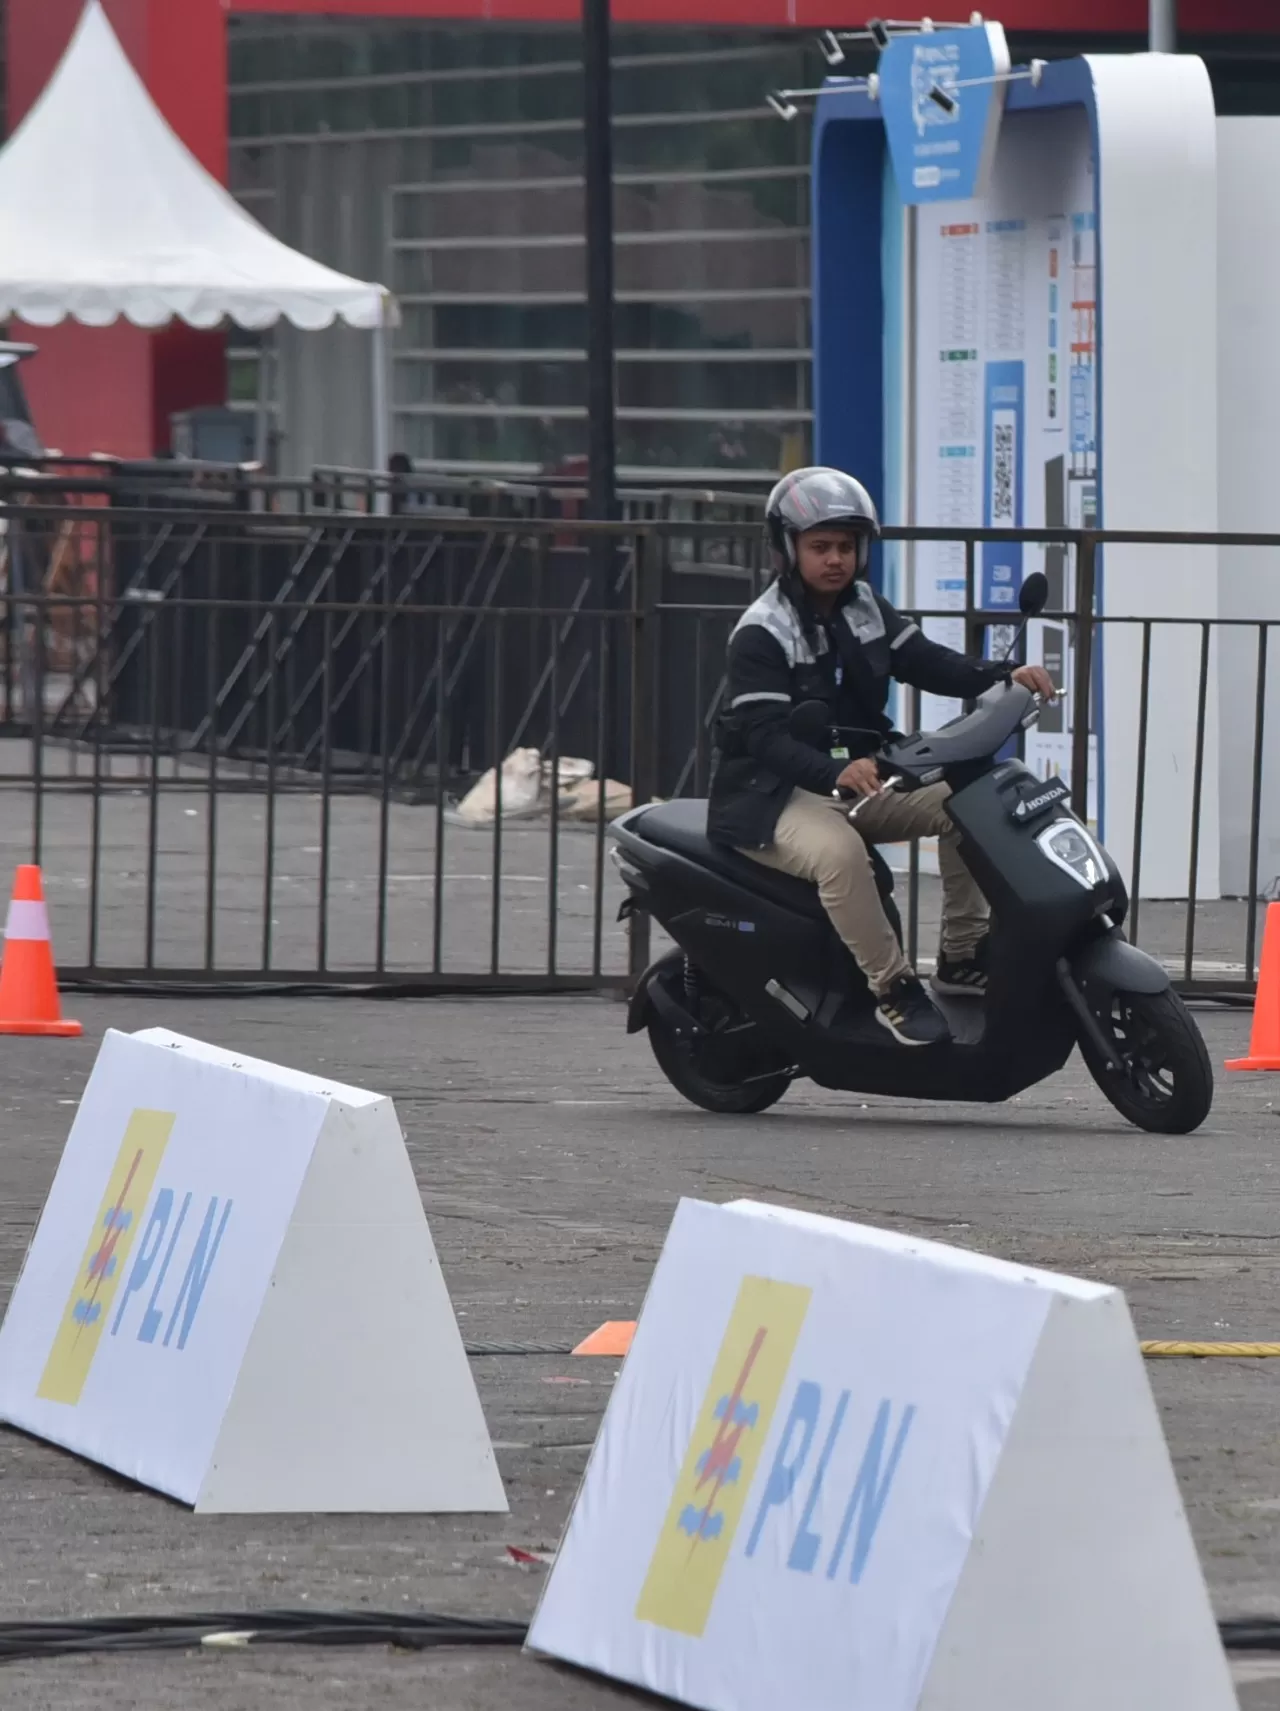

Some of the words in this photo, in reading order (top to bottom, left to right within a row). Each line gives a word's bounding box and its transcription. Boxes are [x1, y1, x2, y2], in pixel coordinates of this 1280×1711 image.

[1026, 787, 1066, 810] HONDA
[111, 1188, 233, 1350] PLN
[745, 1380, 917, 1584] PLN
